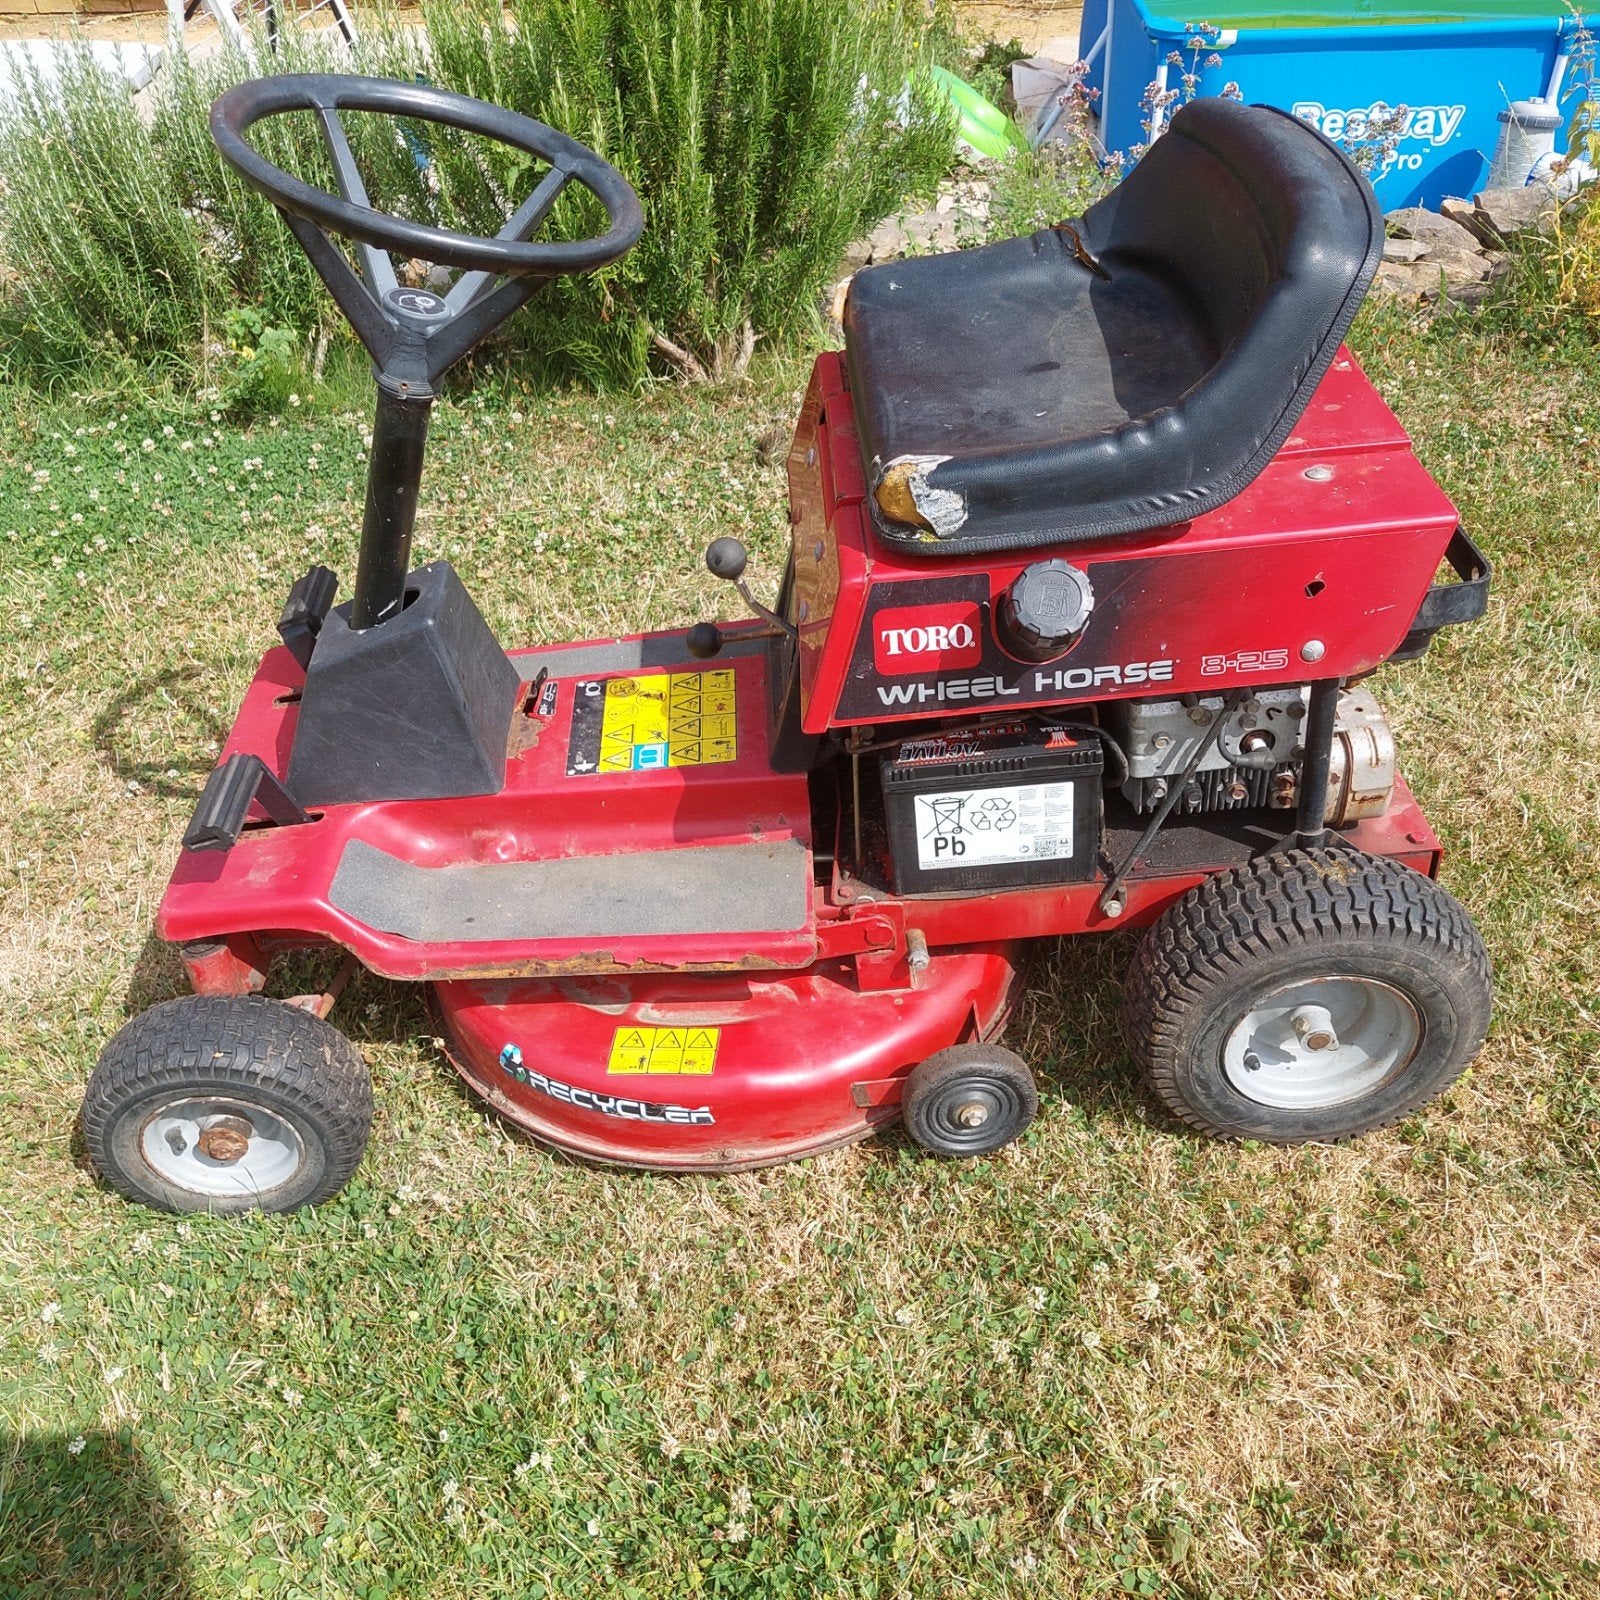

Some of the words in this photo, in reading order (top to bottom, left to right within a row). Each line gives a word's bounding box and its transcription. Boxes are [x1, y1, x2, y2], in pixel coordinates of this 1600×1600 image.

[881, 623, 974, 656] TORO
[1200, 649, 1289, 676] 8-25
[876, 676, 1020, 706] WHEEL
[1034, 659, 1173, 692] HORSE
[897, 741, 980, 763] ACTIVE
[933, 836, 967, 858] Pb
[528, 1070, 716, 1124] RECYCLER
